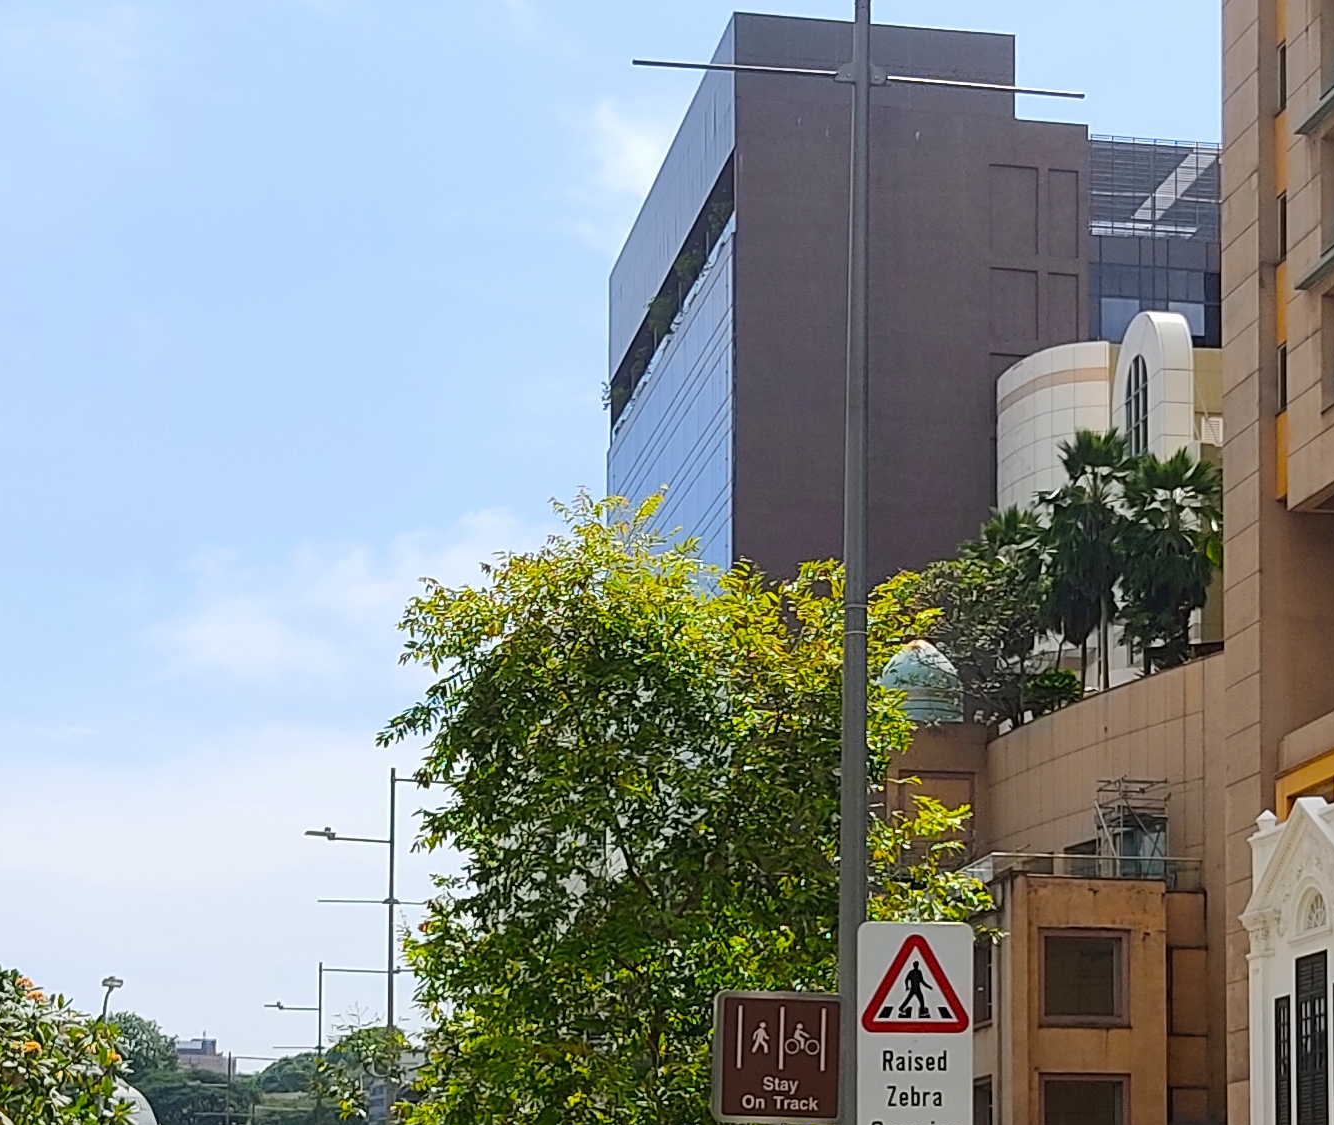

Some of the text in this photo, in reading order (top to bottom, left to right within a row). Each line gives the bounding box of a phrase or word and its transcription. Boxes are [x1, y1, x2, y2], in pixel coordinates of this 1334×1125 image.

[882, 1050, 948, 1072] Raised
[762, 1076, 799, 1095] Stay
[742, 1095, 818, 1111] On Track
[887, 1086, 942, 1107] Zebra
